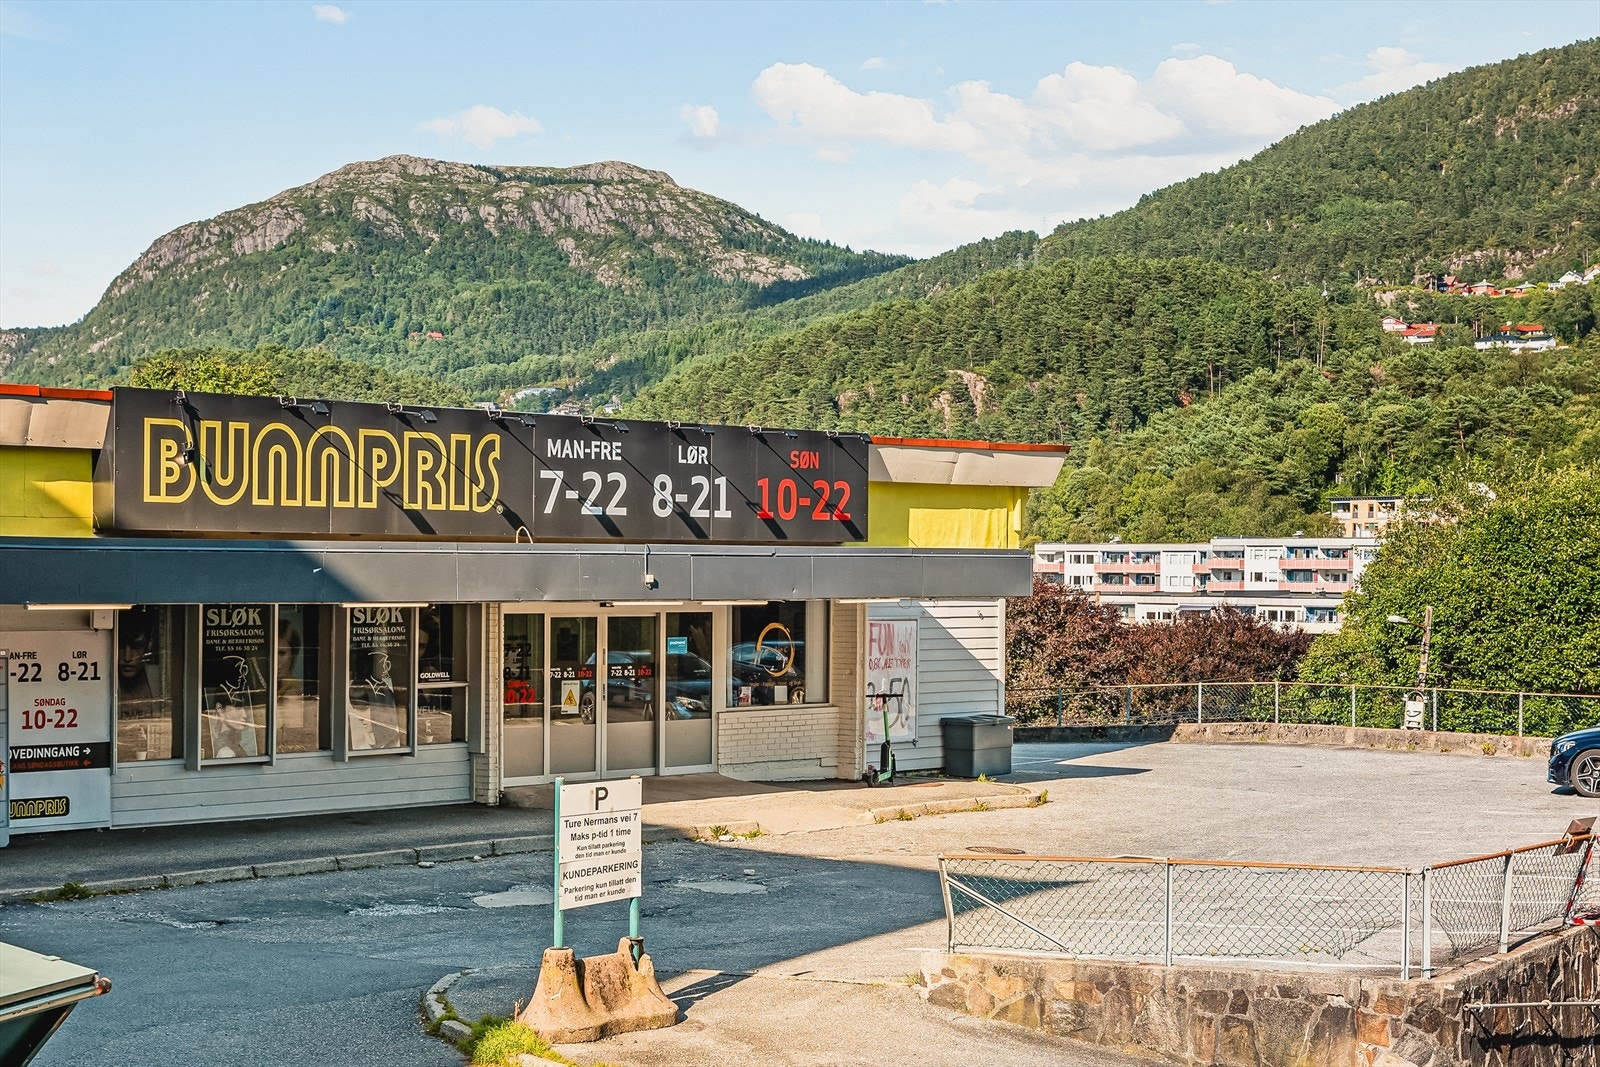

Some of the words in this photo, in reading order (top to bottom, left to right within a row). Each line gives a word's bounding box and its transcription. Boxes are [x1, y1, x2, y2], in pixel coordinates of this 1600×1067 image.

[547, 438, 622, 461] MAN-FRE
[678, 445, 709, 465] LØR
[143, 417, 500, 513] BUNNPRIS
[790, 450, 819, 469] SØN
[540, 470, 628, 516] 7-22
[652, 473, 732, 518] 8-21
[757, 477, 851, 521] 10-22
[206, 606, 262, 628] SLØK
[353, 607, 404, 625] SLØK
[206, 629, 264, 637] FRISØRSALONG
[353, 626, 406, 634] FRISØRSALONG
[869, 623, 894, 656] FUN
[9, 651, 37, 660] AN-FRE
[72, 651, 88, 659] LØR
[9, 663, 42, 682] -22
[58, 662, 101, 681] 8-21
[563, 670, 575, 678] 8-21
[34, 698, 66, 707] SØNDAG
[21, 709, 78, 730] 10-22
[9, 746, 80, 760] VEDINNGANG
[28, 760, 79, 769] SØNDAGSBUTIKK
[10, 798, 66, 817] UNNPRIS
[595, 786, 609, 811] P
[564, 820, 581, 828] Ture
[584, 816, 618, 827] Nermans
[620, 814, 632, 822] vei
[633, 813, 638, 821] 7
[570, 832, 590, 841] Maks
[591, 830, 608, 840] p-tid
[610, 829, 614, 837] 1
[616, 828, 632, 836] time
[602, 841, 625, 849] parkering
[562, 860, 639, 881] KUNDEPARKERING
[564, 883, 595, 894] Parkering
[608, 878, 624, 886] tillatt
[625, 876, 637, 884] den
[584, 892, 598, 900] man
[607, 887, 626, 896] kunde
